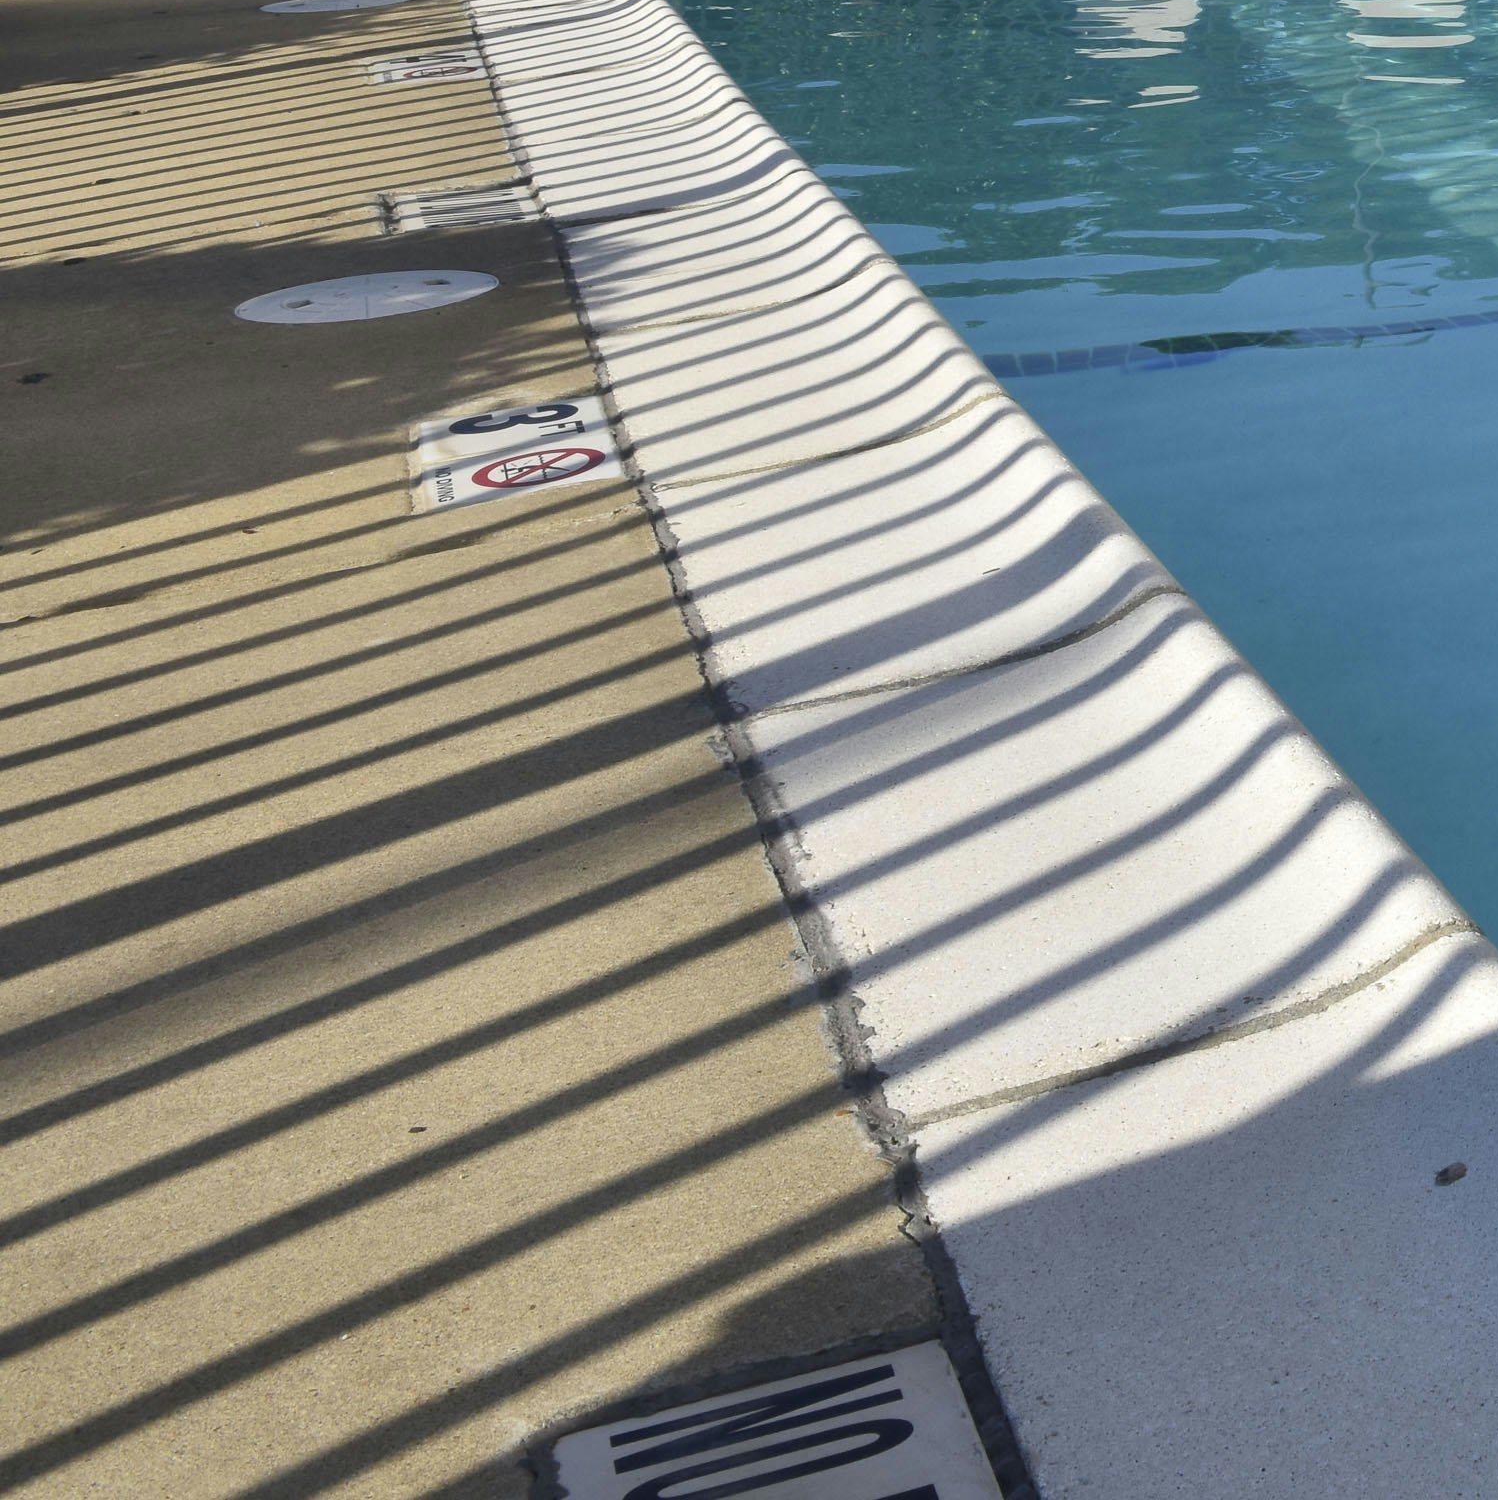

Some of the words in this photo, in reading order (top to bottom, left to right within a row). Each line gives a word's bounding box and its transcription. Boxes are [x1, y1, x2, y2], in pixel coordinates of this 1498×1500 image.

[449, 404, 579, 435] 3
[538, 419, 586, 437] FT
[436, 479, 455, 503] DIVING
